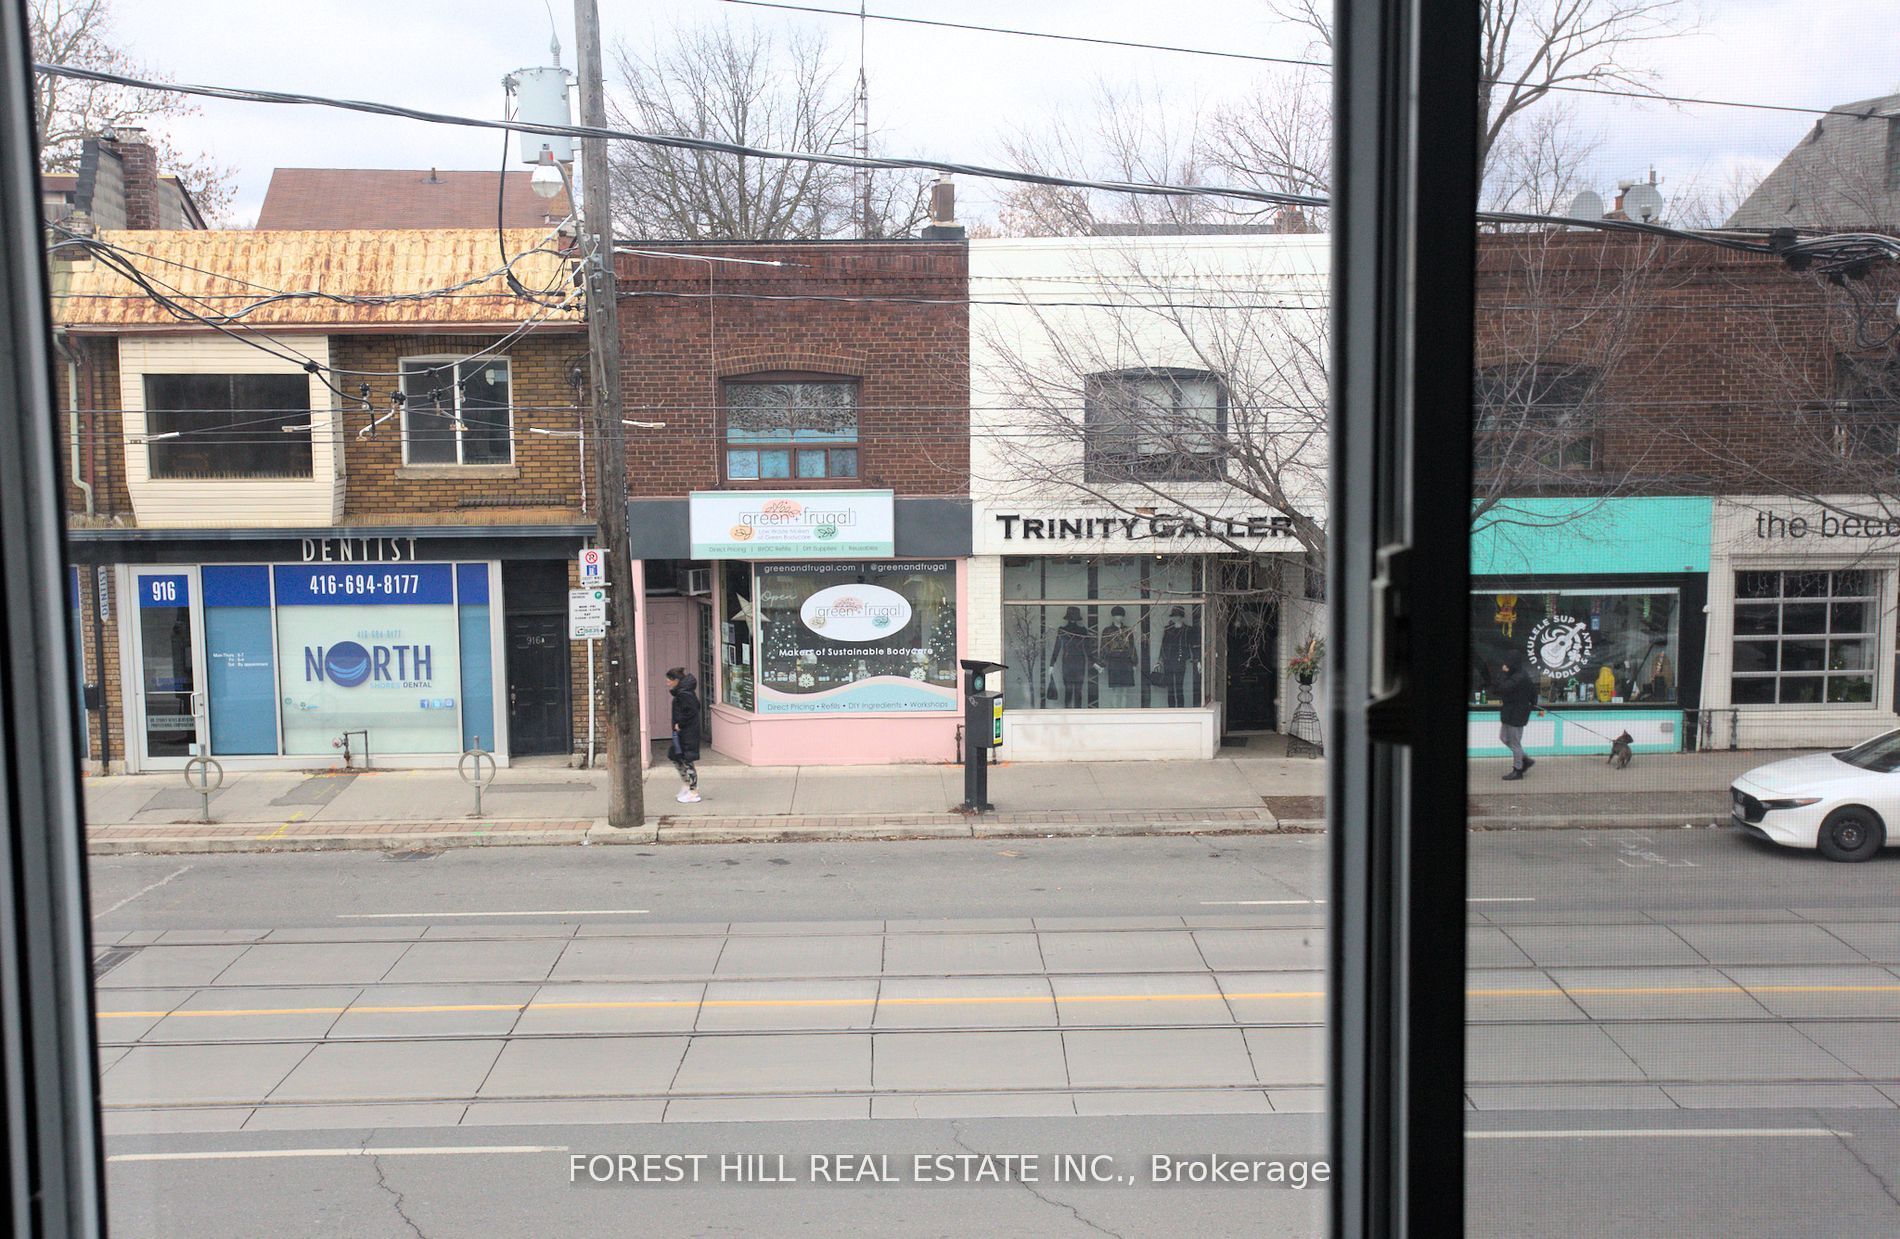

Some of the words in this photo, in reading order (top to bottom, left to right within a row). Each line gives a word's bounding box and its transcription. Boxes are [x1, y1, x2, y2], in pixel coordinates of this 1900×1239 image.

[742, 511, 790, 531] green
[804, 507, 852, 530] frugal
[1149, 514, 1314, 539] GALLER
[1756, 511, 1808, 538] the
[302, 537, 417, 561] DENTIST
[764, 563, 856, 574] greenandfrugal.com
[870, 562, 947, 573] @greenandfrugal
[152, 581, 176, 601] 916
[310, 574, 419, 594] 416-694-8177
[760, 590, 798, 607] Open
[816, 606, 855, 622] green
[864, 603, 902, 621] frugal
[1526, 618, 1551, 665] UKULELE
[1553, 615, 1576, 624] SUP
[779, 647, 815, 656] Makers
[816, 647, 826, 656] of
[828, 647, 884, 656] Sustainable
[1543, 664, 1581, 679] PADDLE
[1582, 632, 1593, 656] PLAY
[304, 641, 432, 688] NORTH
[403, 681, 432, 689] DENTAL
[768, 703, 789, 711] Direct
[790, 703, 815, 713] Pricing
[821, 702, 841, 711] Refills
[848, 702, 860, 710] DIY
[909, 700, 948, 710] Workshops
